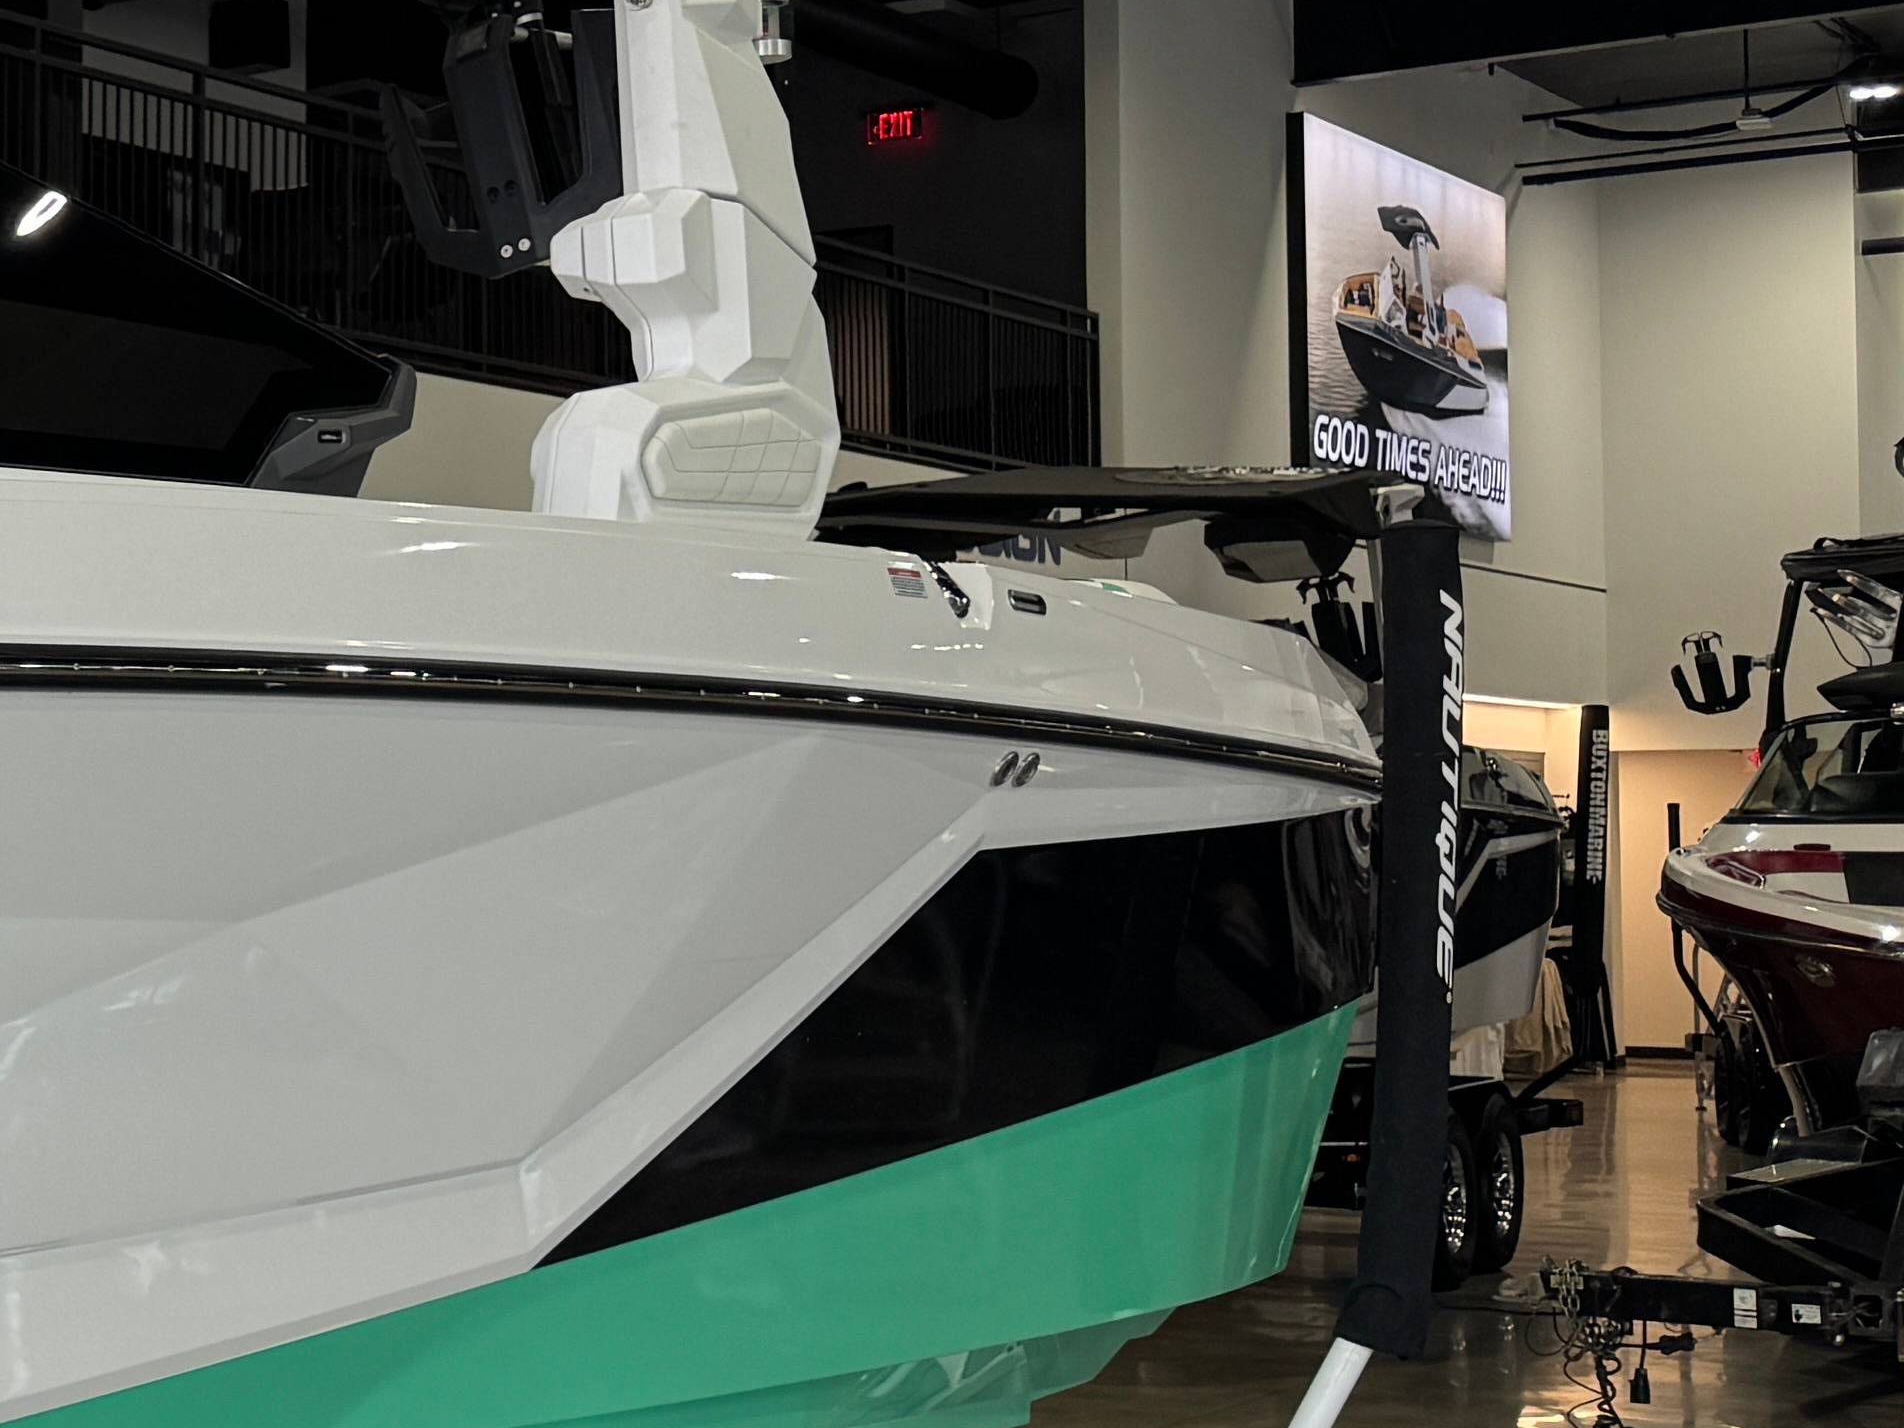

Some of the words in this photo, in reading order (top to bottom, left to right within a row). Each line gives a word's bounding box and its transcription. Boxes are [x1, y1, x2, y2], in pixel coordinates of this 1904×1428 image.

[879, 110, 913, 140] EXIT
[1313, 414, 1370, 468] GOOD
[1375, 428, 1432, 482] TIMES
[1434, 444, 1507, 503] AHEAD!!!
[1436, 588, 1463, 989] NAUTIQUE
